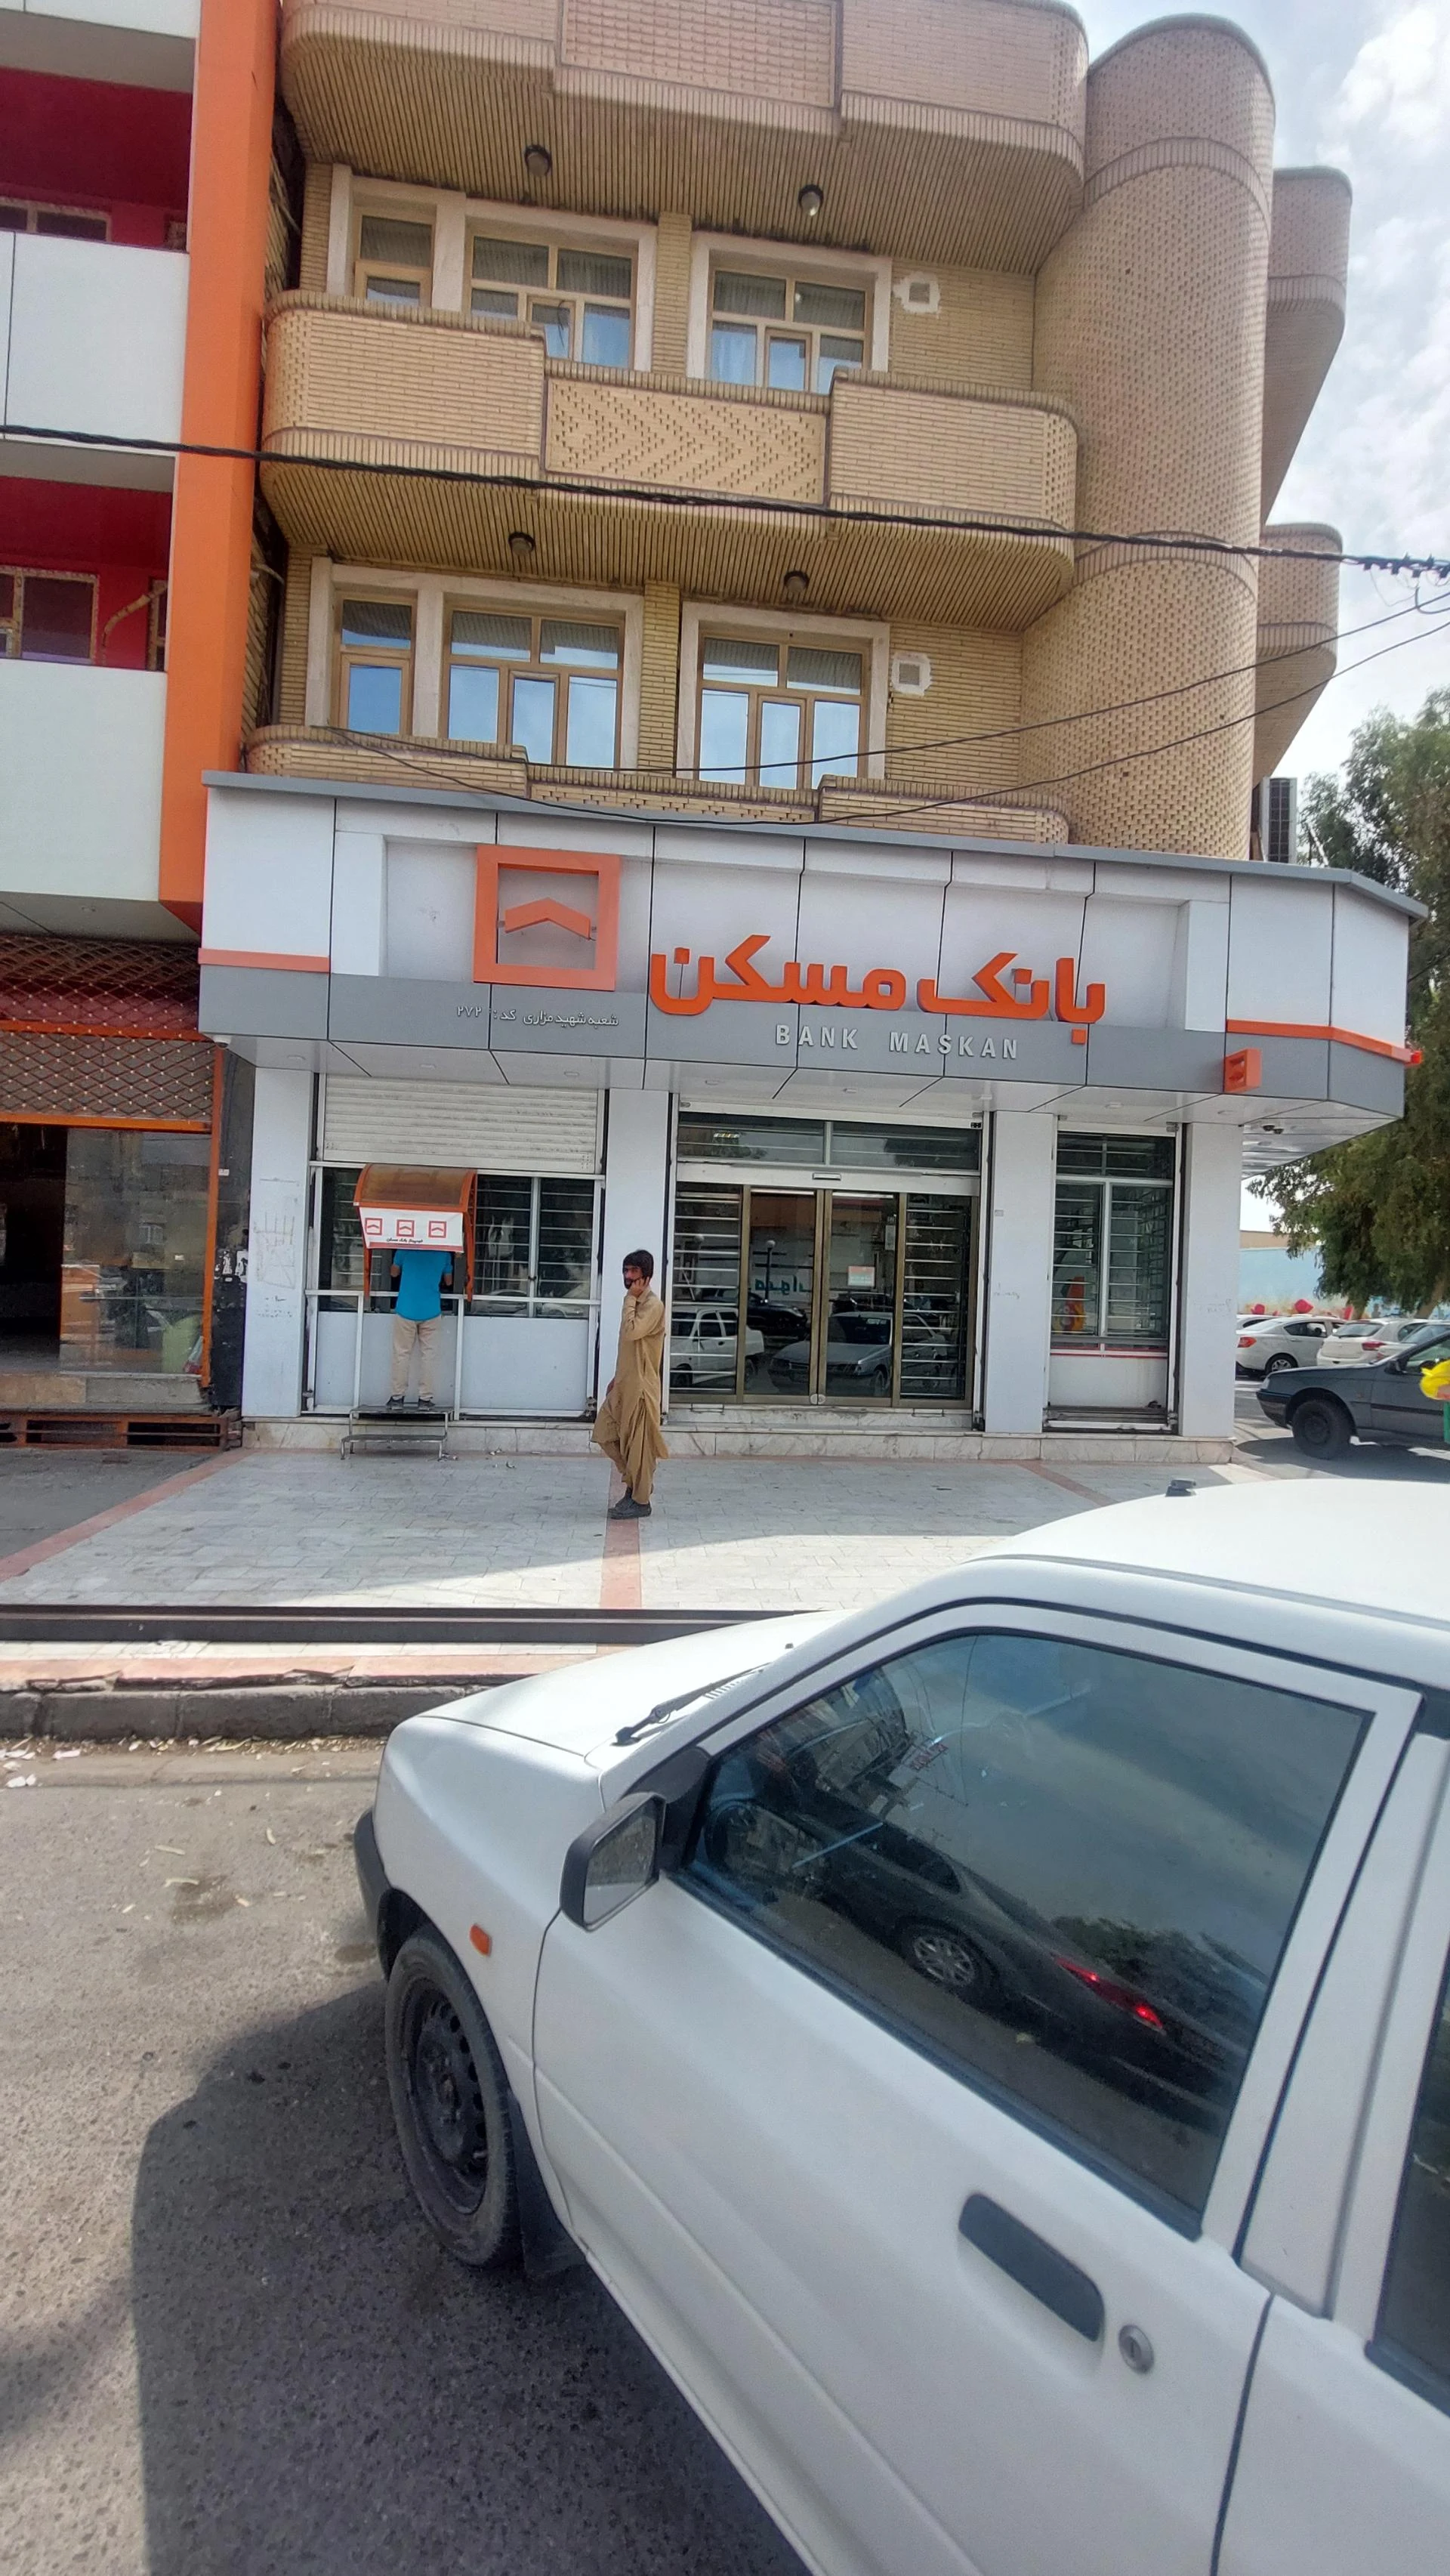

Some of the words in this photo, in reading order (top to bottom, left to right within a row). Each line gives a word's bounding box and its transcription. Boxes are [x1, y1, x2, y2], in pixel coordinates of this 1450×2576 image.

[649, 934, 906, 1015] مسکن
[916, 952, 1105, 1045] بانک
[458, 1005, 482, 1017] ۲۷۲
[523, 1010, 554, 1025] مزاری
[555, 1012, 586, 1028] شهید
[588, 1013, 619, 1029] شعبه
[776, 1024, 858, 1049] BANK
[890, 1031, 1018, 1059] MASKAN
